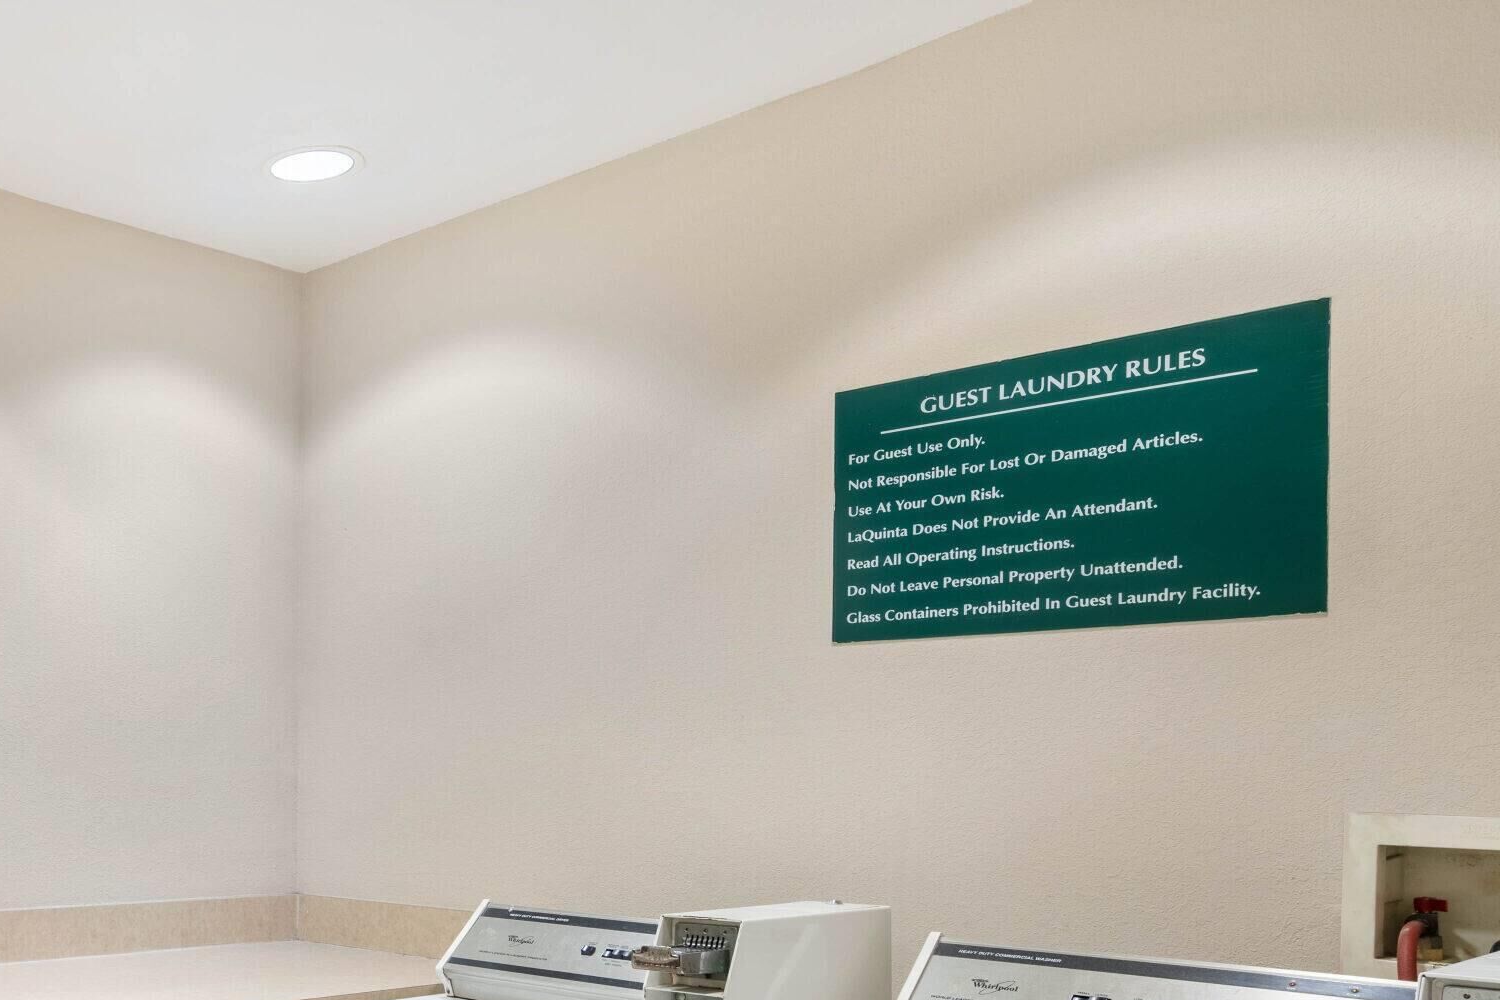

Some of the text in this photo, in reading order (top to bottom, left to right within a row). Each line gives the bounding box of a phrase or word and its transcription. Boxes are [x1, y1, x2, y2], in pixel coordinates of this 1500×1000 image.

[920, 347, 1206, 414] GUEST LAUNDRY RULES
[848, 433, 986, 466] For Guest Use Only.
[848, 431, 1204, 491] Not Responsible For Lost Or Damaged Articles.
[847, 497, 1158, 544] LaQuinta Does Not Provide An Attendant.
[848, 486, 1005, 518] Use At Your Own Risk.
[847, 538, 1075, 571] Read All Operating Instructions.
[847, 555, 1183, 597] Do Not Leave Personal Property Unattended.
[846, 582, 1261, 624] Glass Containers Prohibited In Guest Laundry Facility.
[972, 981, 1020, 993] Whirlpool
